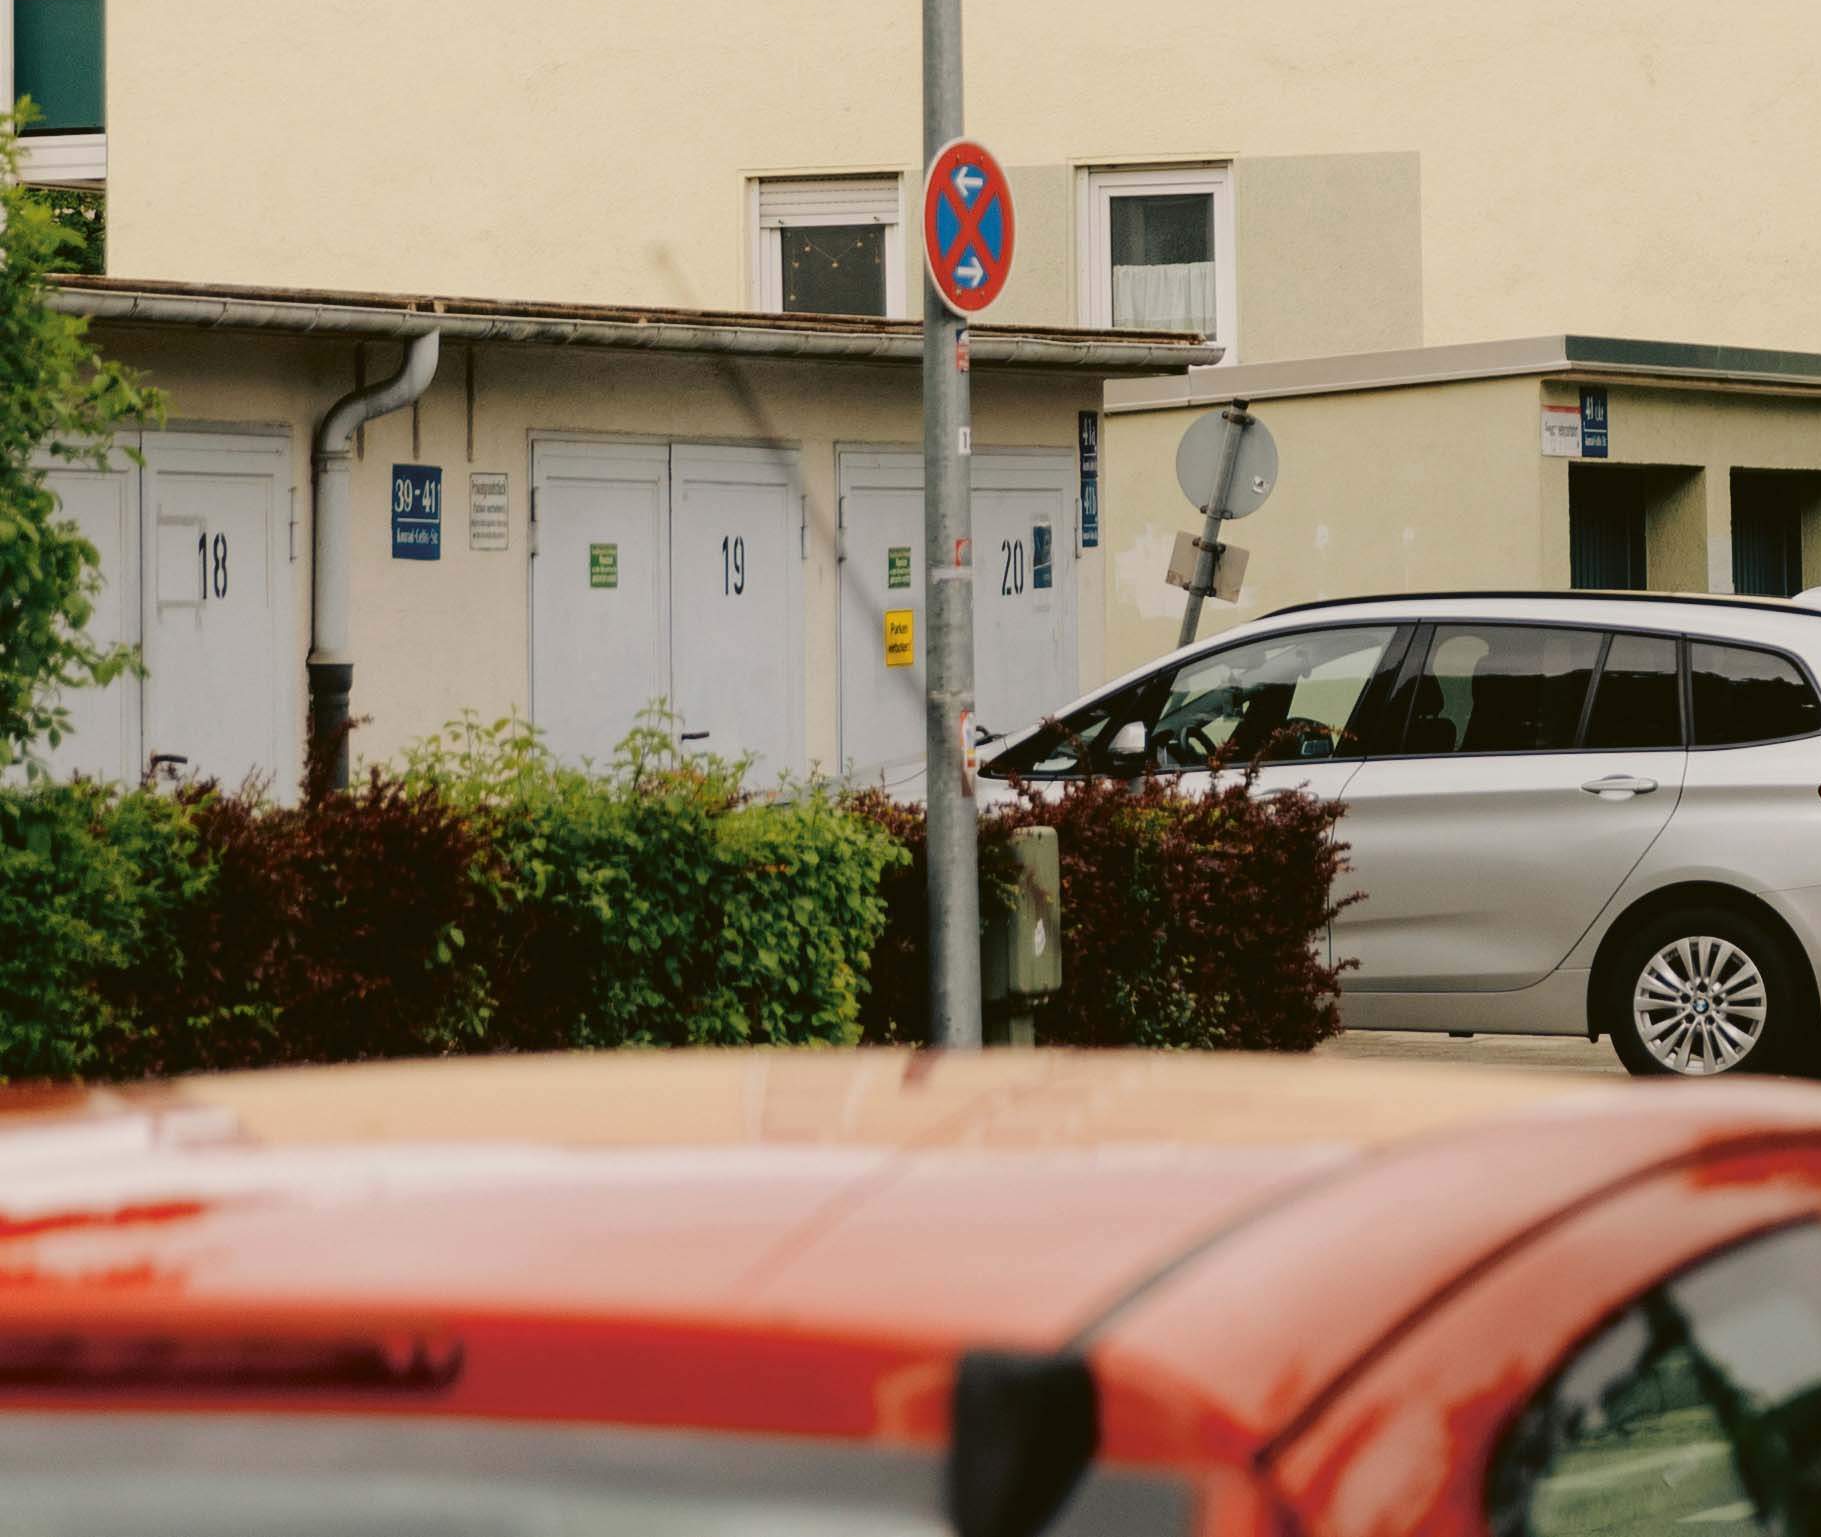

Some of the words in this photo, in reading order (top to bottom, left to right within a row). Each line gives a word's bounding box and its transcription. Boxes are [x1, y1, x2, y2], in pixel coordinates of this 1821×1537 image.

[199, 533, 227, 600] 18
[723, 535, 744, 595] 19
[1002, 540, 1023, 595] 20
